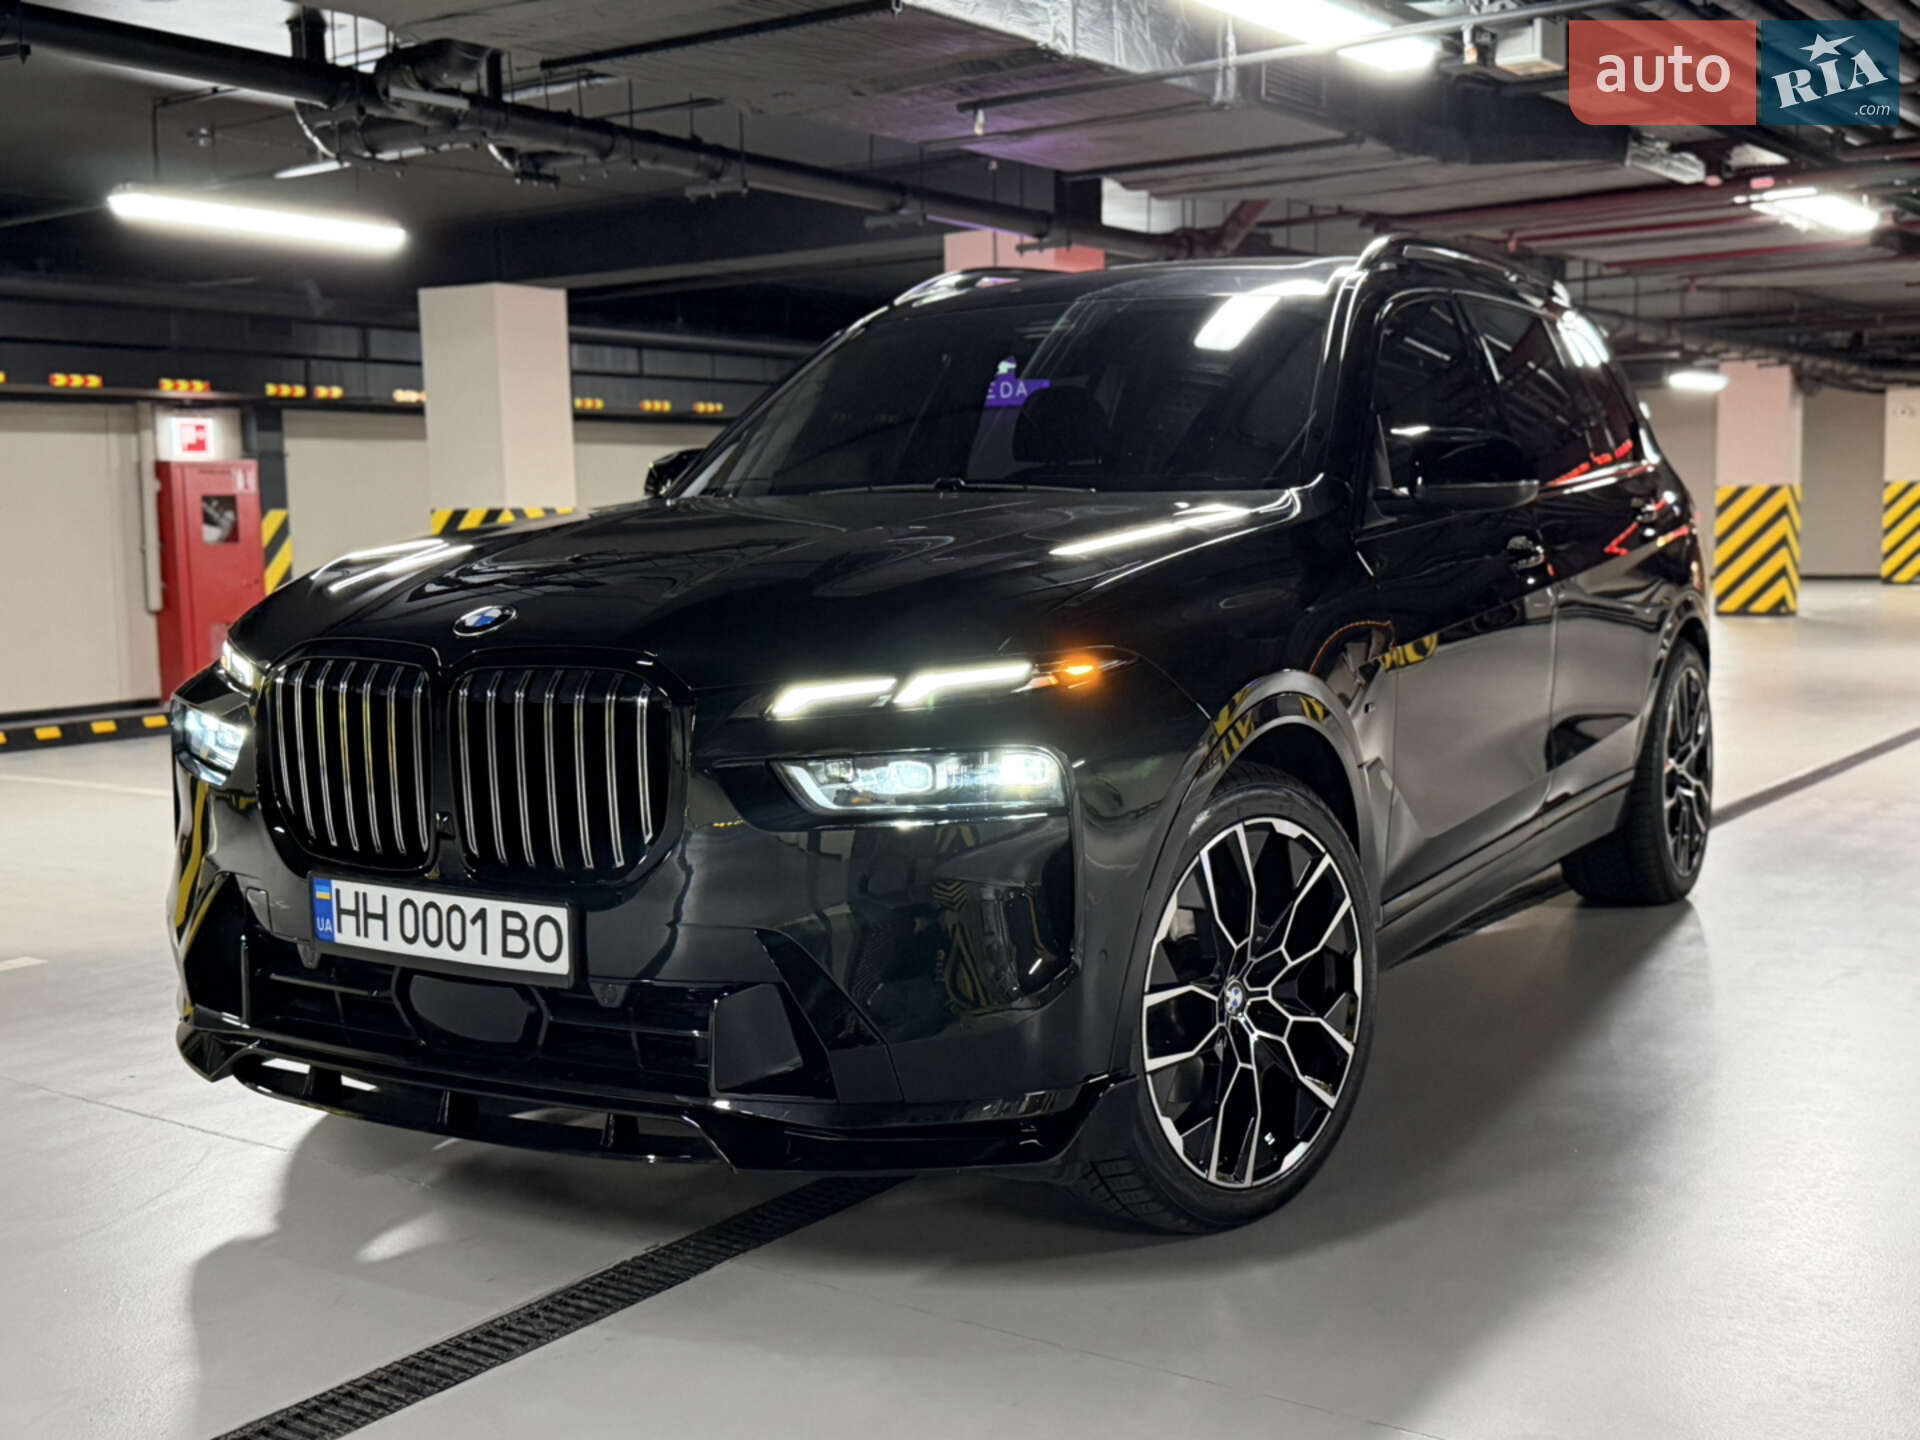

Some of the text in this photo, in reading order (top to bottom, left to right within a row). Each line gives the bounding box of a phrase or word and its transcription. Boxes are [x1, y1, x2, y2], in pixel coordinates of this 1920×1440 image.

[316, 916, 333, 934] UA
[335, 888, 564, 964] HH 0001 BO
